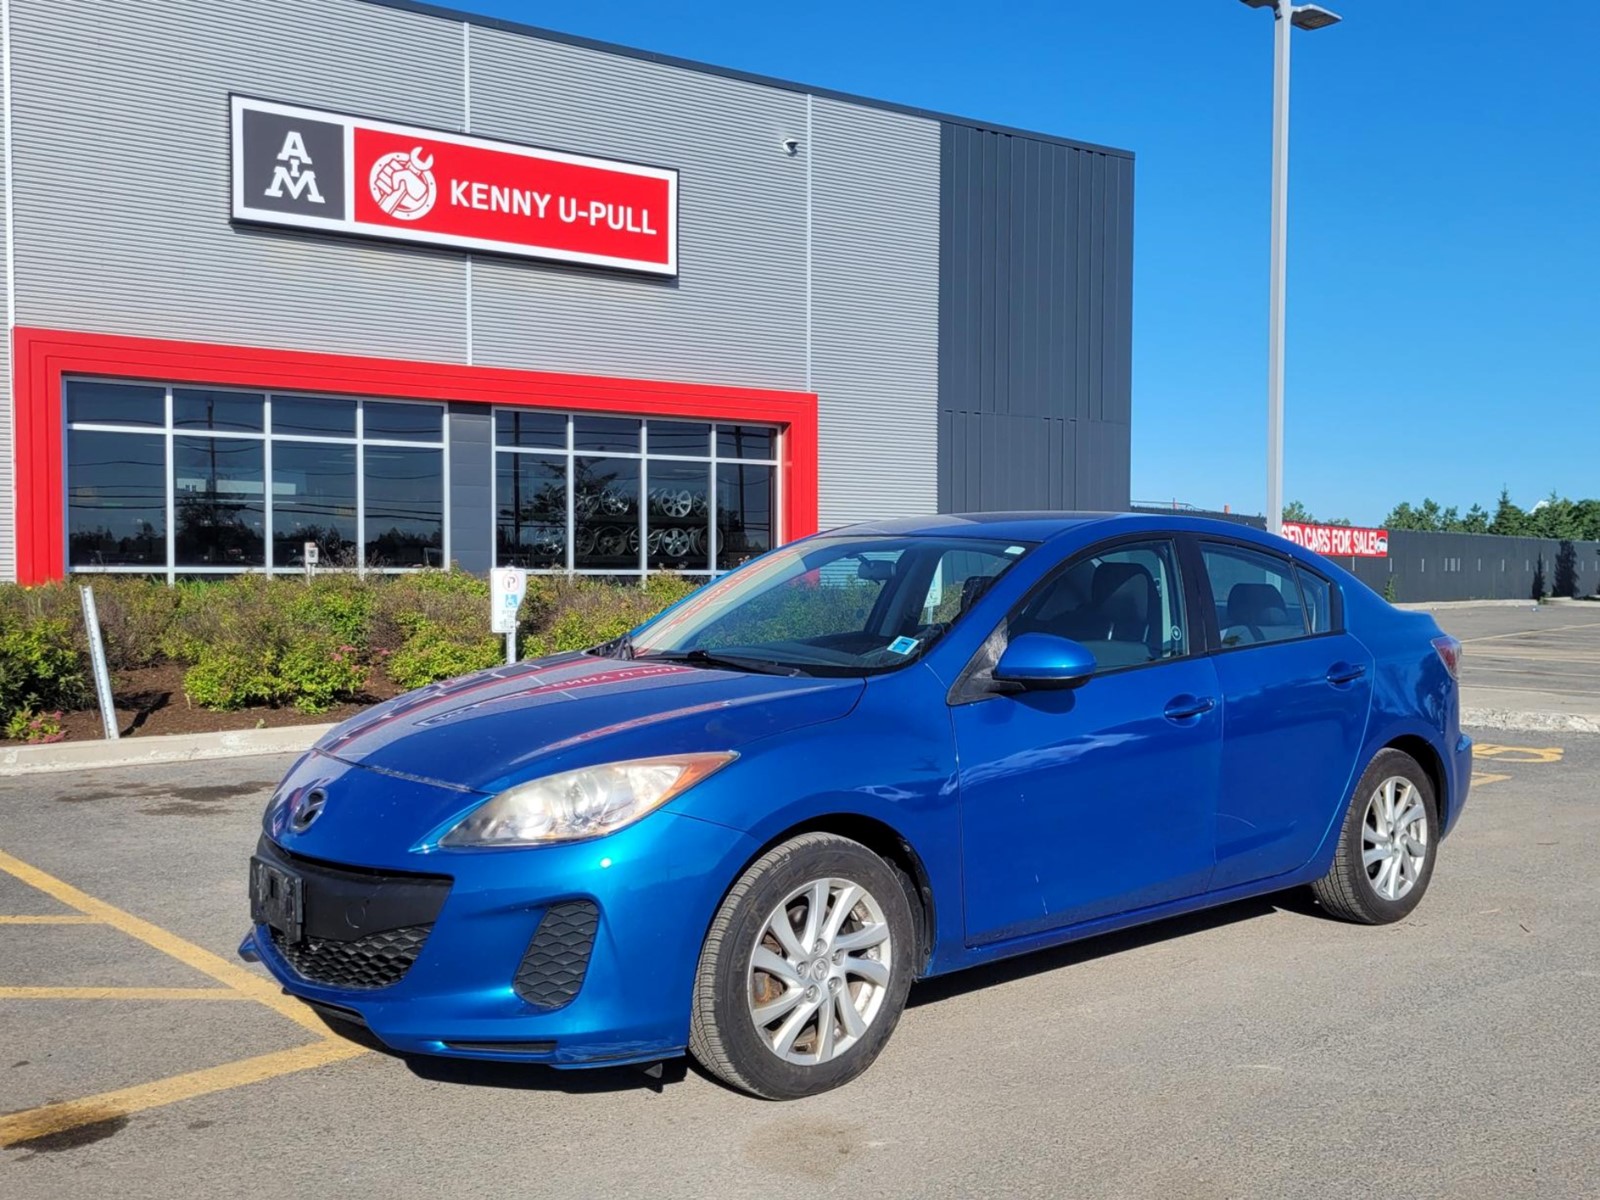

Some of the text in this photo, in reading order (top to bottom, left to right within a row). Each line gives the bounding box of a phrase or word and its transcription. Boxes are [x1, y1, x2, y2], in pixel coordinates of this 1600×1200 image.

[451, 179, 657, 235] KENNY U-PULL
[1304, 527, 1330, 553] CARS
[1331, 529, 1352, 554] FOR
